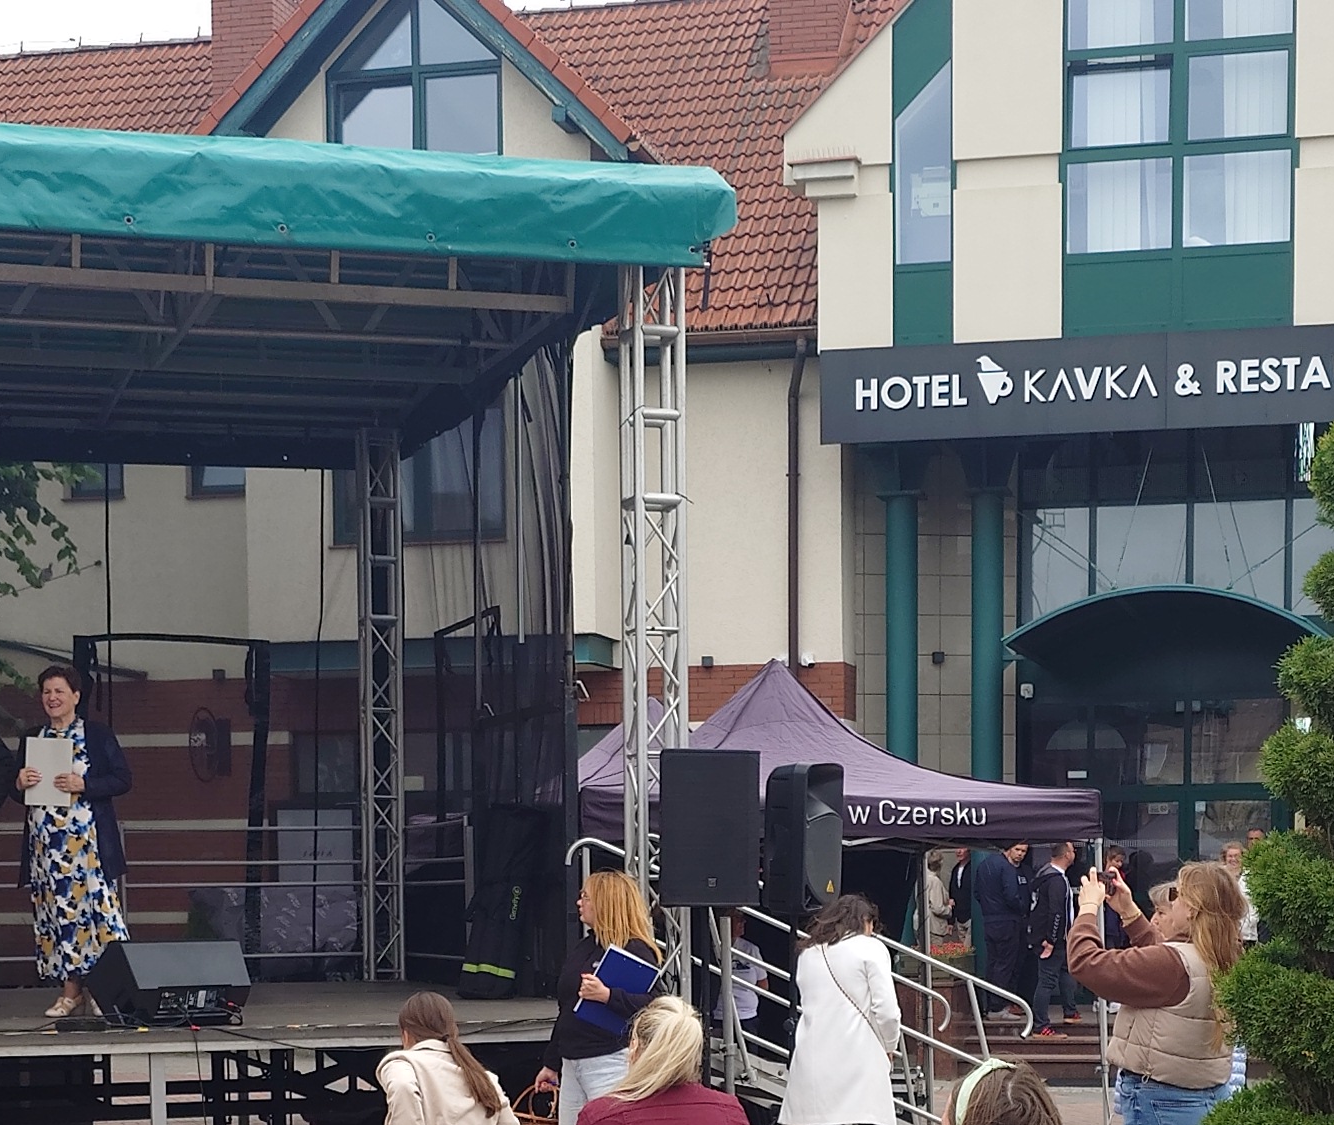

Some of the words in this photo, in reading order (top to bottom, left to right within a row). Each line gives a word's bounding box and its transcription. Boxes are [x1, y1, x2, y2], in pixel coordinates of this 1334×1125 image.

[855, 374, 968, 411] HOTEL
[1024, 364, 1159, 403] KAVKA
[1174, 363, 1202, 397] &
[847, 805, 871, 825] w
[878, 800, 987, 825] Czersku
